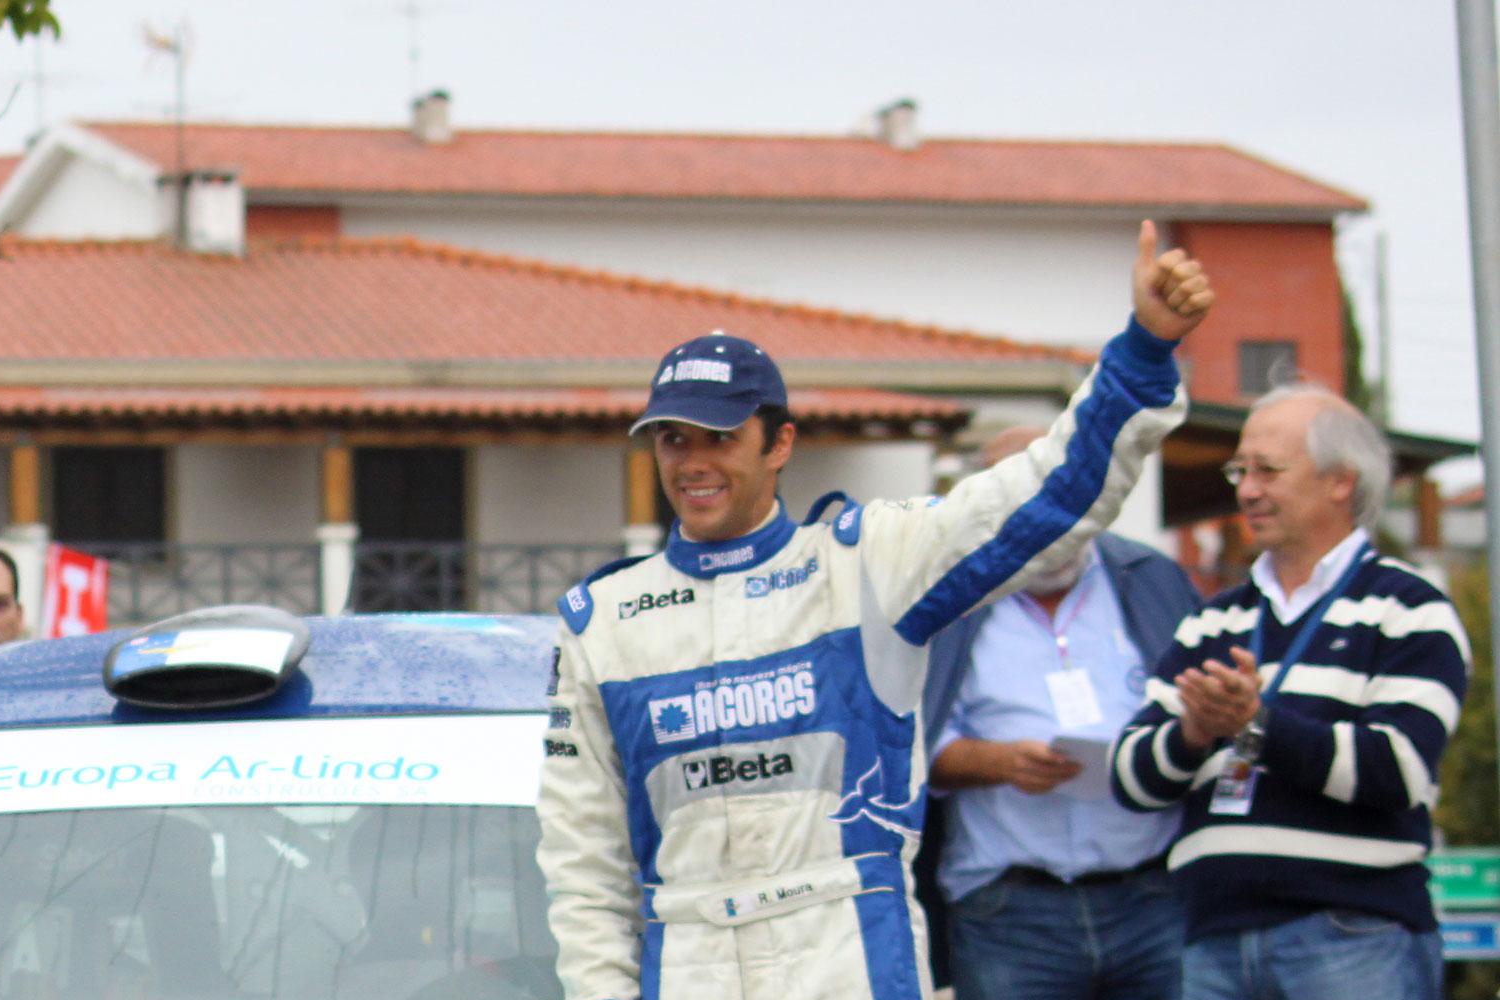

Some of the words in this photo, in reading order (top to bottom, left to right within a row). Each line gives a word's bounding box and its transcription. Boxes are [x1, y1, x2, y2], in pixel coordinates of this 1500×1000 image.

[638, 588, 695, 612] Beta
[199, 755, 440, 782] Ar-Lindo
[710, 752, 793, 785] Beta
[776, 883, 813, 900] Moura
